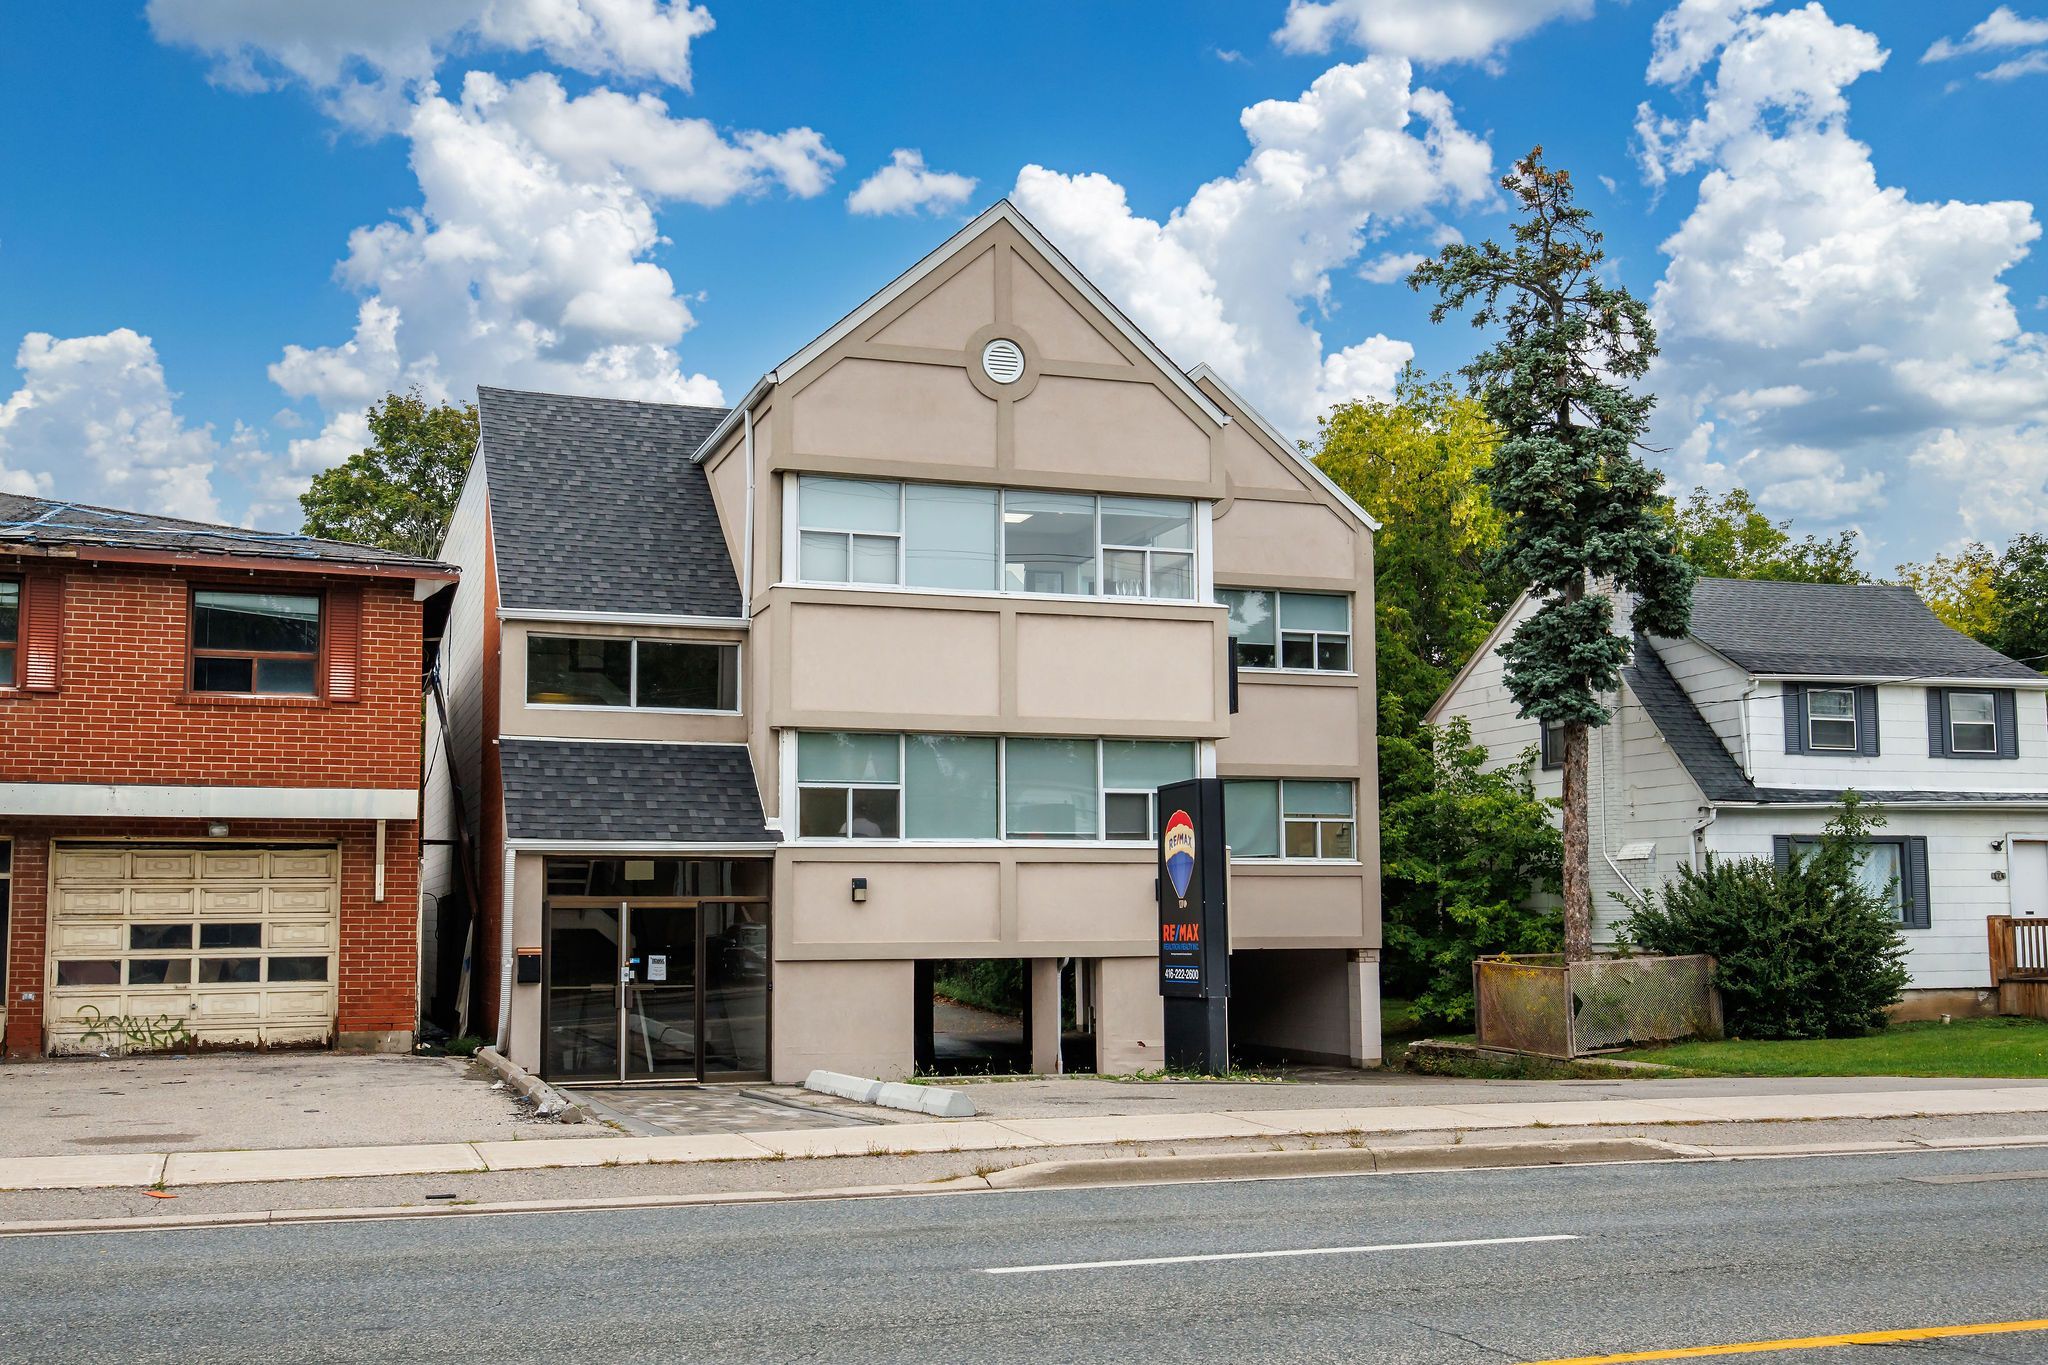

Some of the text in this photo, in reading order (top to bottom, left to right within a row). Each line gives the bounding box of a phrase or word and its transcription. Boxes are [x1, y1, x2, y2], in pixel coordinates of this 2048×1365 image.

[1168, 833, 1193, 849] RE/MAX
[1163, 924, 1199, 941] RE/MAX
[1165, 968, 1199, 980] 416-222-2600
